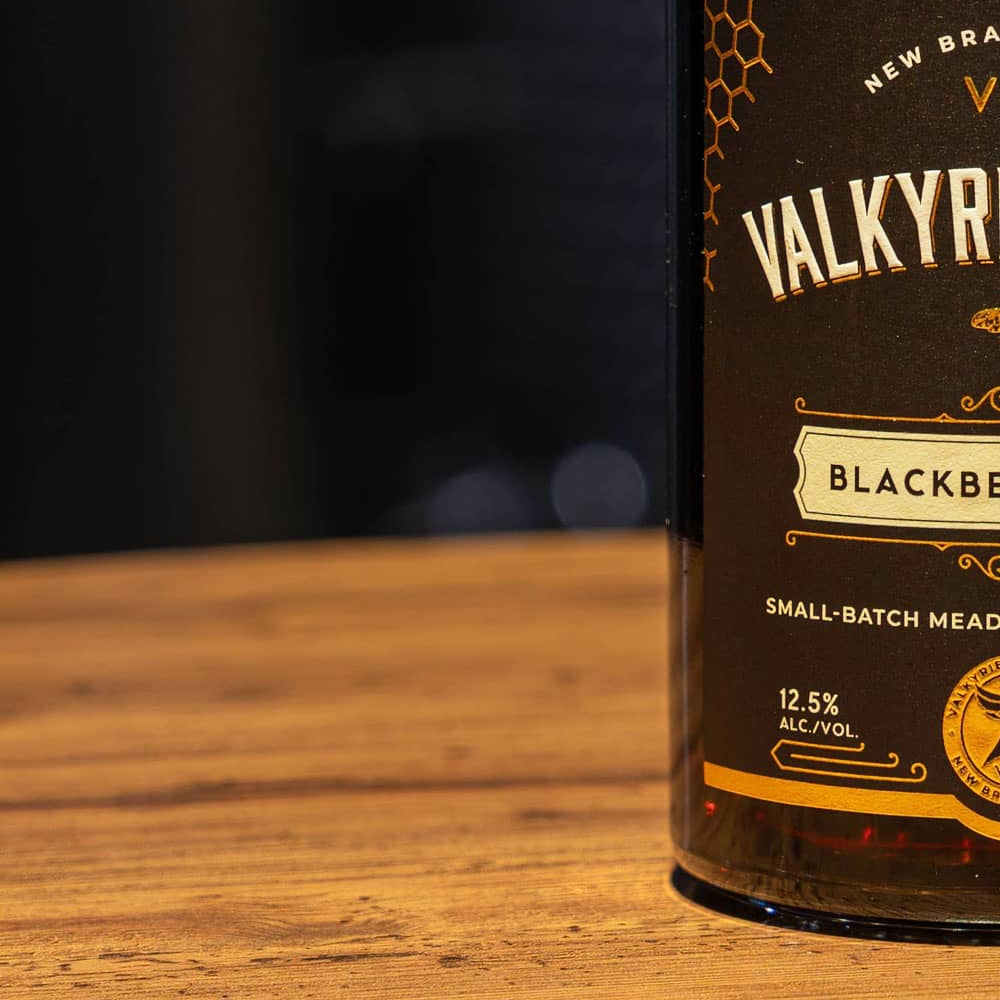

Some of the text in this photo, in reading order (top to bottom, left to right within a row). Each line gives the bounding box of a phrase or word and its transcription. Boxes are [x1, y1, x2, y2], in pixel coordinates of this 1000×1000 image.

[864, 46, 922, 94] NEW
[766, 597, 919, 629] SMALL-BATCH
[779, 688, 839, 716] 12.5%
[779, 717, 858, 738] ALC./VOL.
[951, 755, 979, 786] NEW
